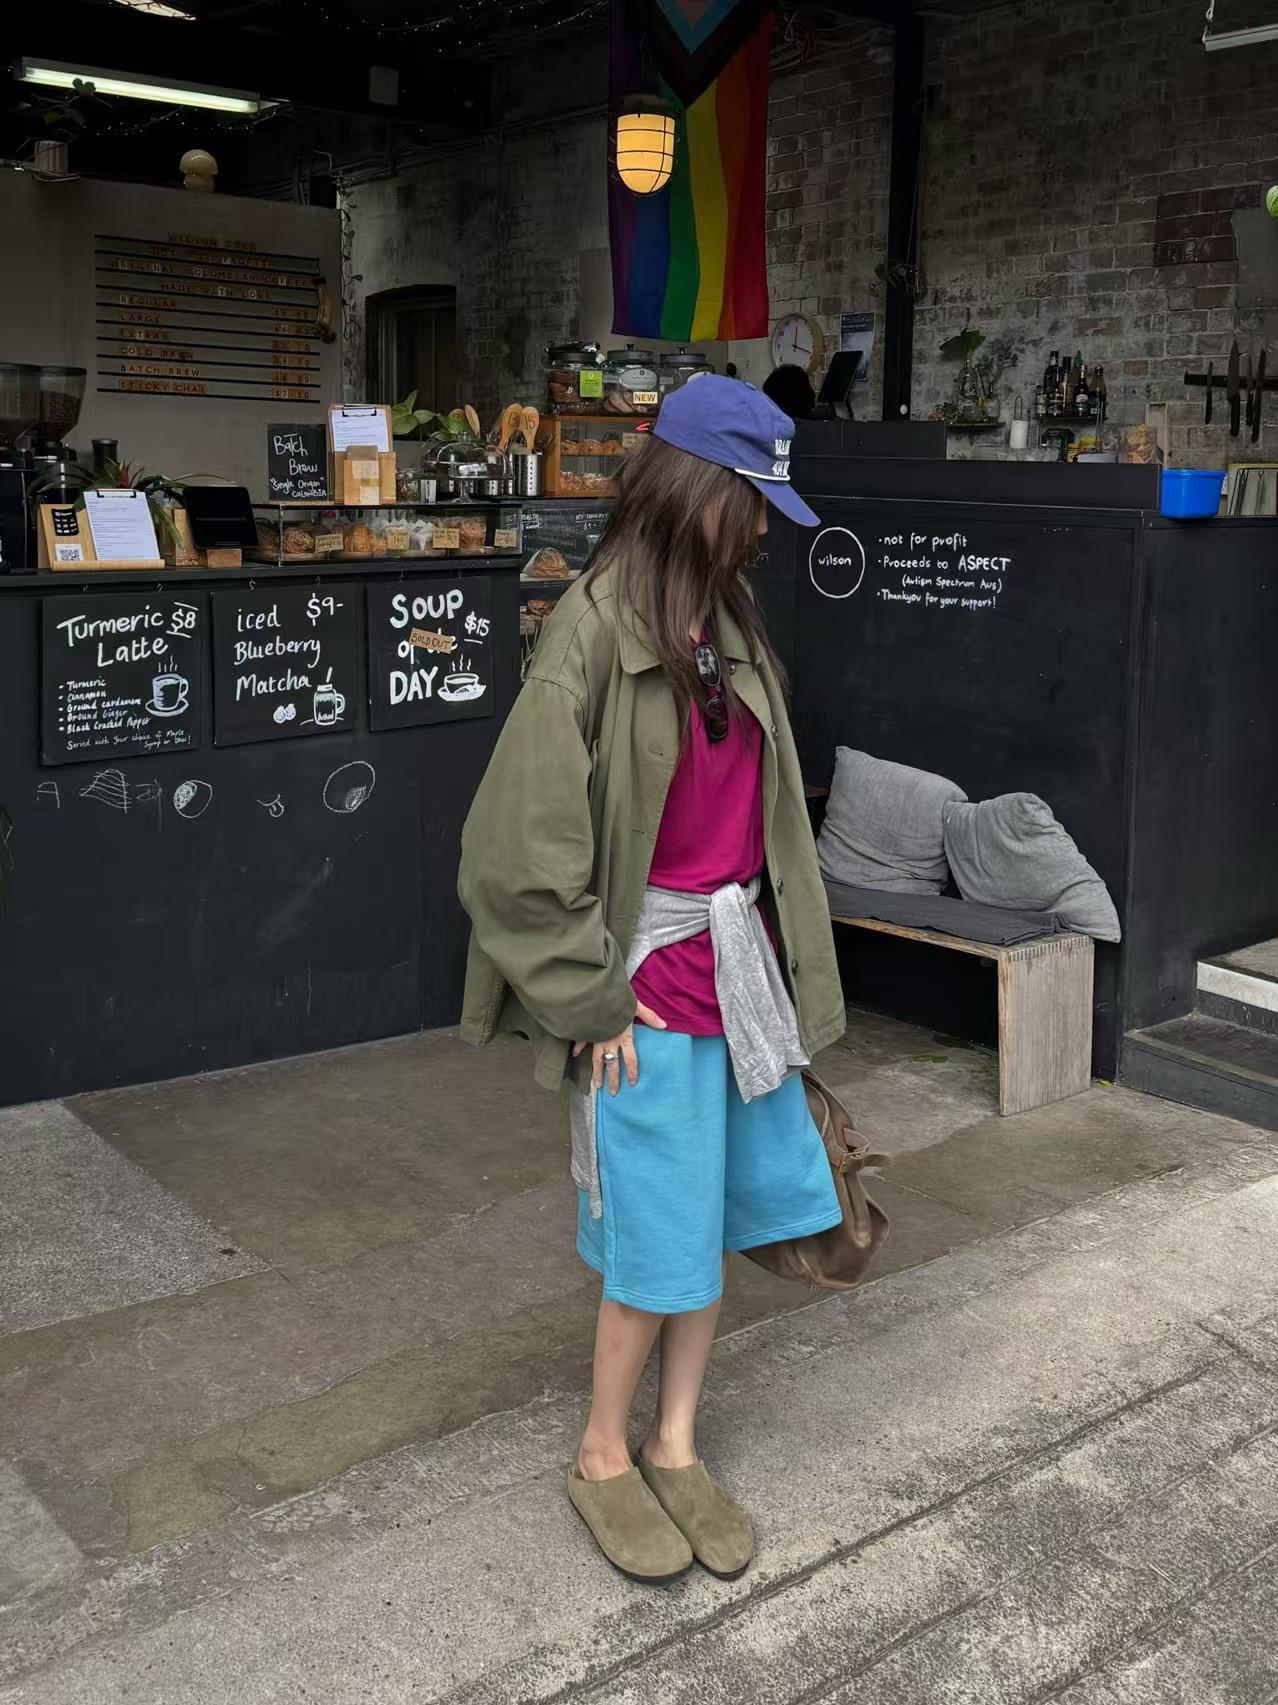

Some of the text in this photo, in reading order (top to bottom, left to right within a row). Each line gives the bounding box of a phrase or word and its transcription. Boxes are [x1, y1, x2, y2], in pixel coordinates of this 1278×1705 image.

[120, 364, 200, 377] BATCH BREW
[120, 381, 168, 391] STICKY
[634, 394, 656, 402] NEW
[273, 433, 308, 456] Batch
[289, 458, 318, 476] Brew
[884, 532, 967, 553] not for profit
[818, 555, 852, 567] wilson
[883, 554, 1012, 573] Proceeds to ASPECT
[935, 576, 976, 590] Spectrum
[389, 588, 464, 629] SOUP
[925, 591, 939, 607] for
[940, 597, 958, 609] your
[960, 595, 997, 611] support!
[56, 604, 197, 648] Turmeric $8
[236, 605, 281, 632] iced
[464, 611, 491, 638] $15
[411, 632, 431, 647] SOLD
[431, 637, 451, 650] OUT
[96, 636, 169, 668] Latte
[233, 636, 321, 669] Blueberry
[66, 676, 108, 692] Turmeric
[236, 668, 312, 702] Matcha
[389, 666, 439, 706] DAY
[66, 699, 97, 713] Ground
[67, 711, 98, 722] Ground
